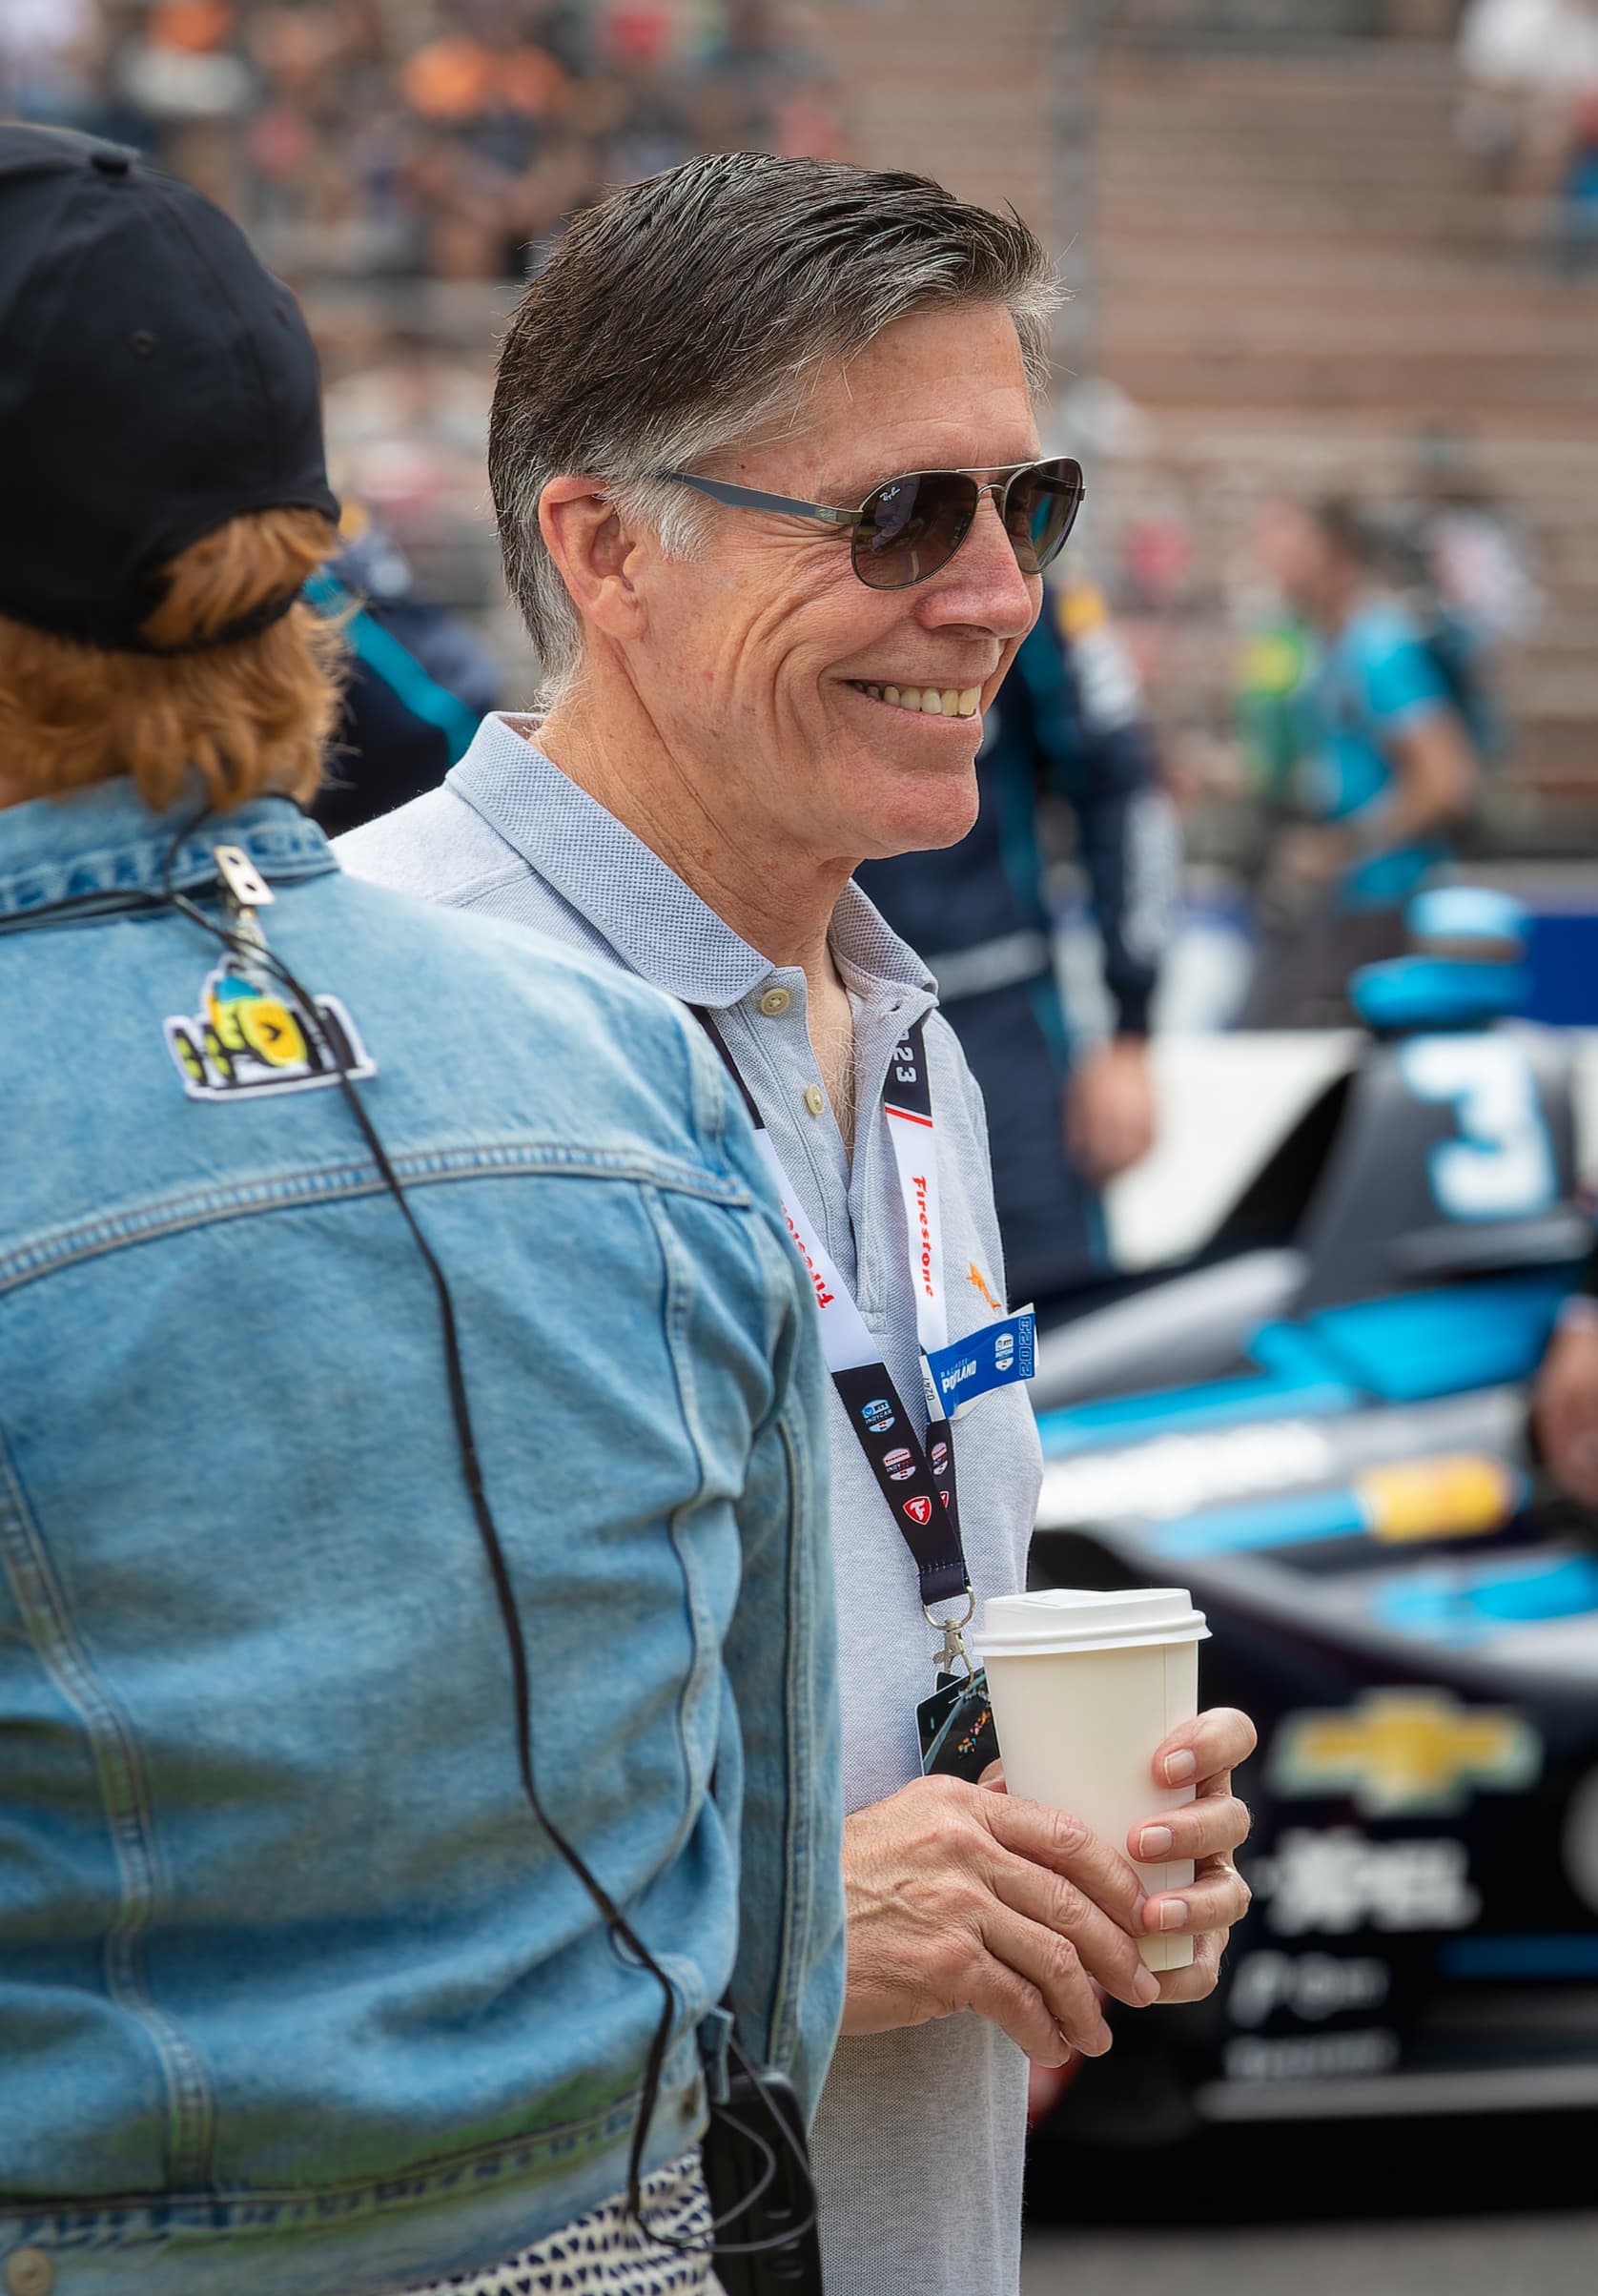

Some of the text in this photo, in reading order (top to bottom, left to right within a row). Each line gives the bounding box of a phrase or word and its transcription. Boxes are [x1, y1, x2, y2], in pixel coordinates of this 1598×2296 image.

[1397, 1030, 1562, 1224] 3
[912, 1176, 933, 1298] Firestone
[1017, 1316, 1035, 1378] 2023
